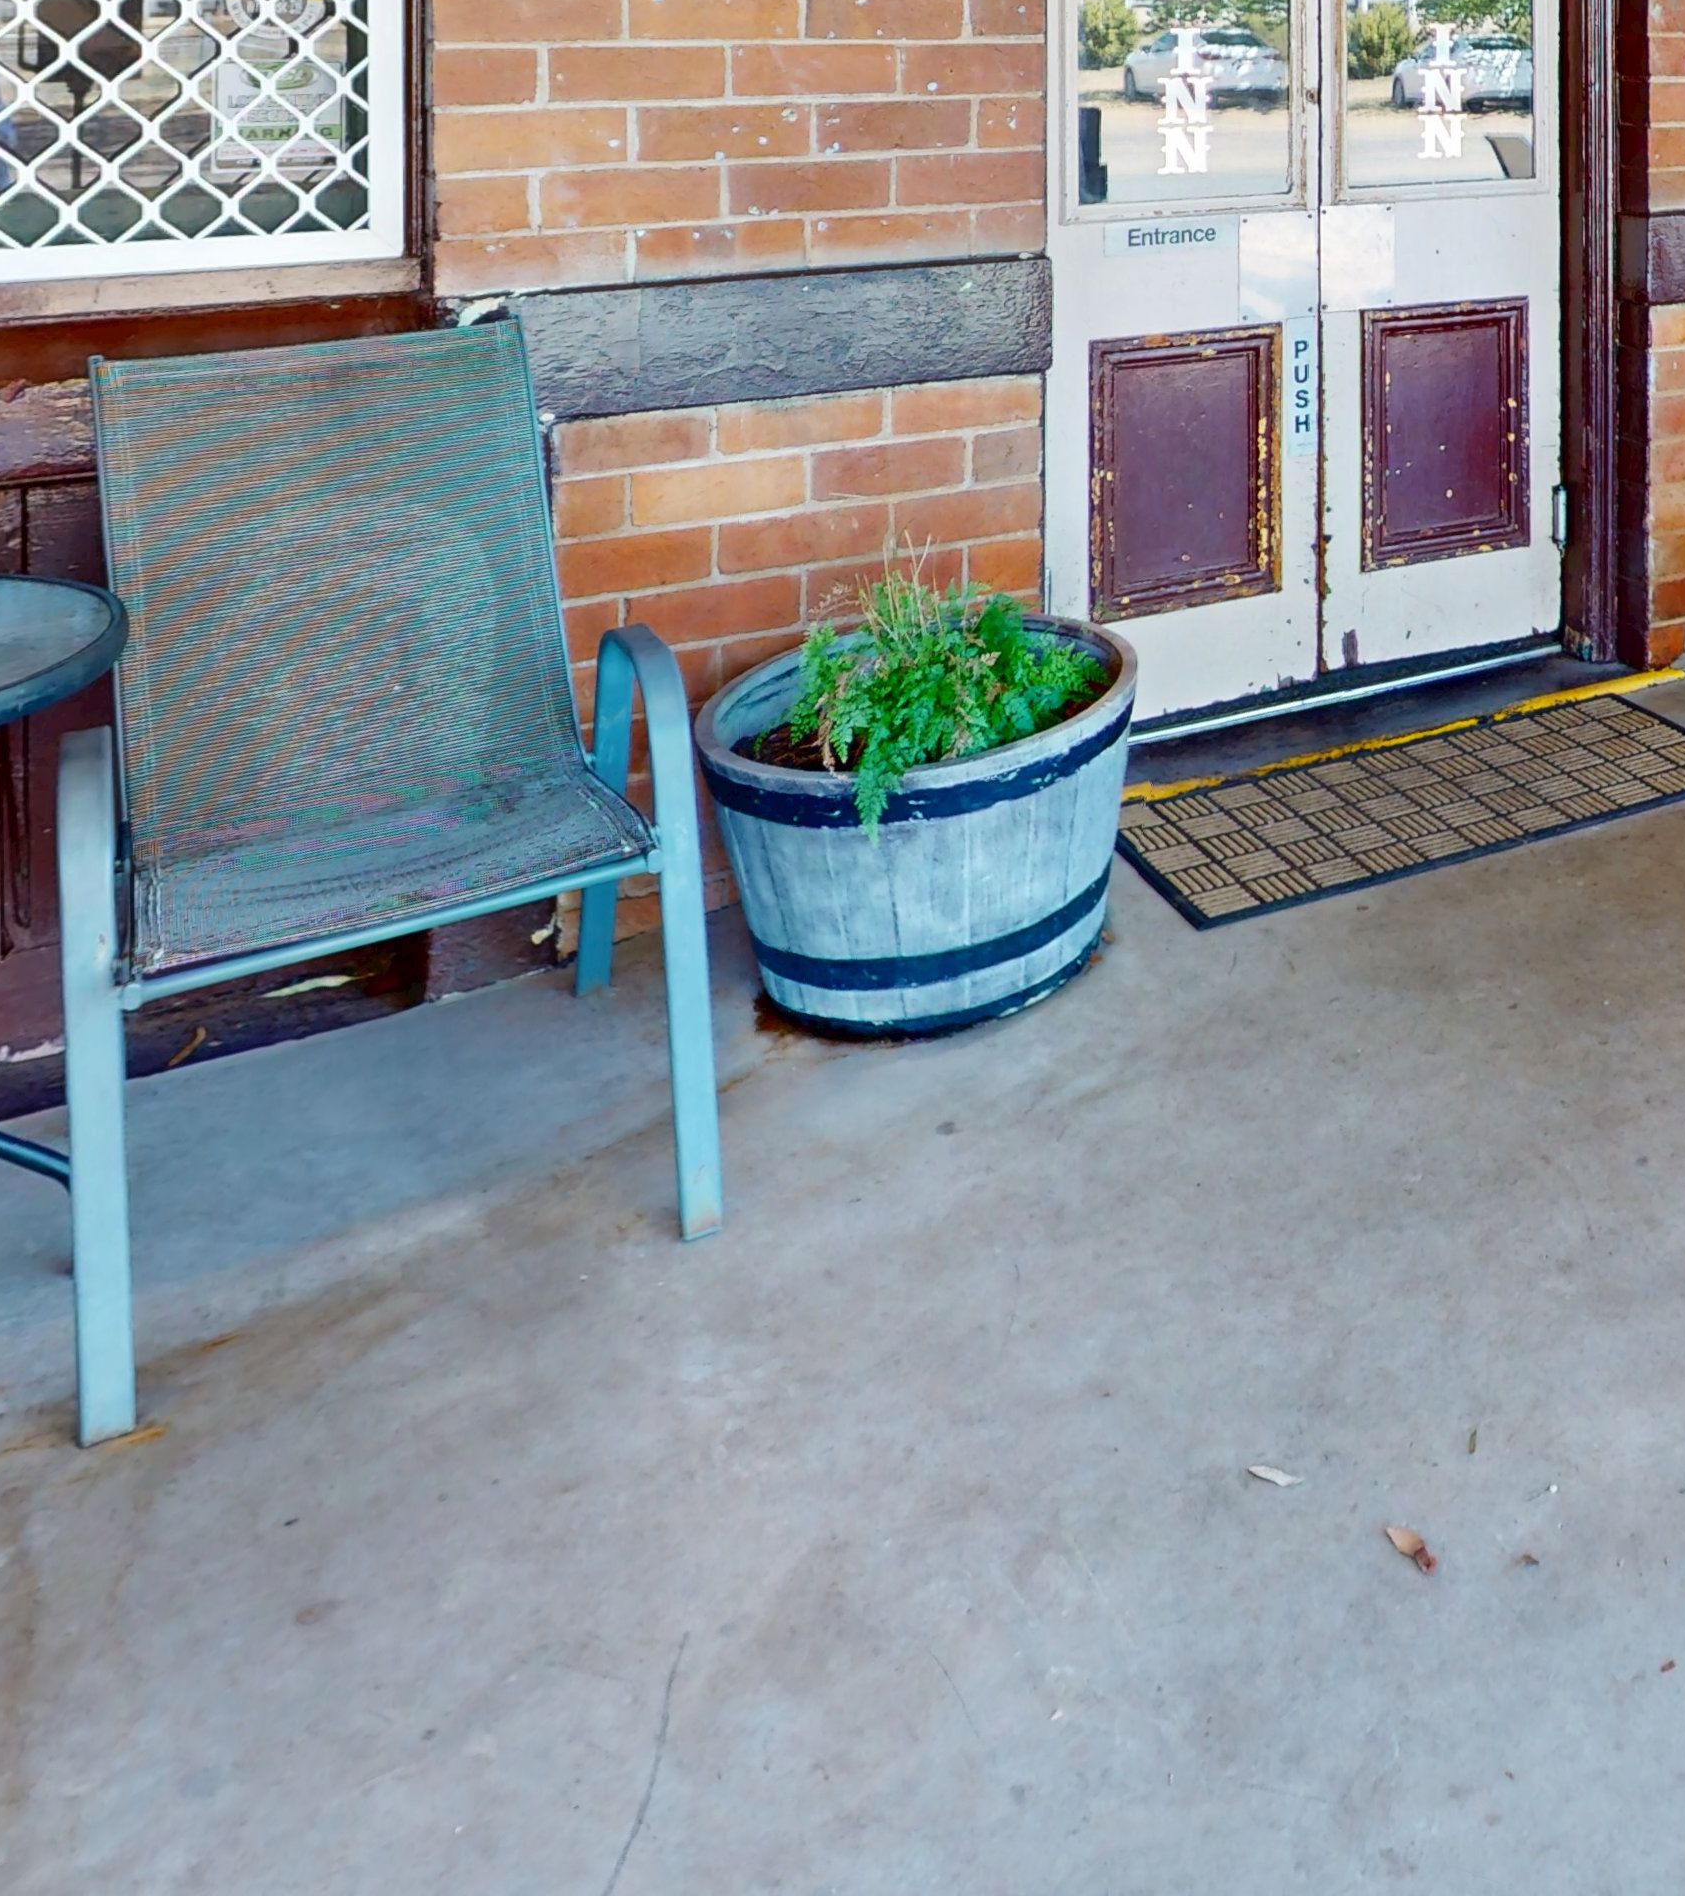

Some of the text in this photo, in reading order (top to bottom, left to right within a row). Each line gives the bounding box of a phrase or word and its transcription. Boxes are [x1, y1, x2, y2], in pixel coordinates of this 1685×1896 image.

[1157, 26, 1211, 175] INN
[1417, 22, 1467, 160] INN
[1127, 227, 1217, 247] Entrance
[1294, 340, 1311, 433] PUSH
